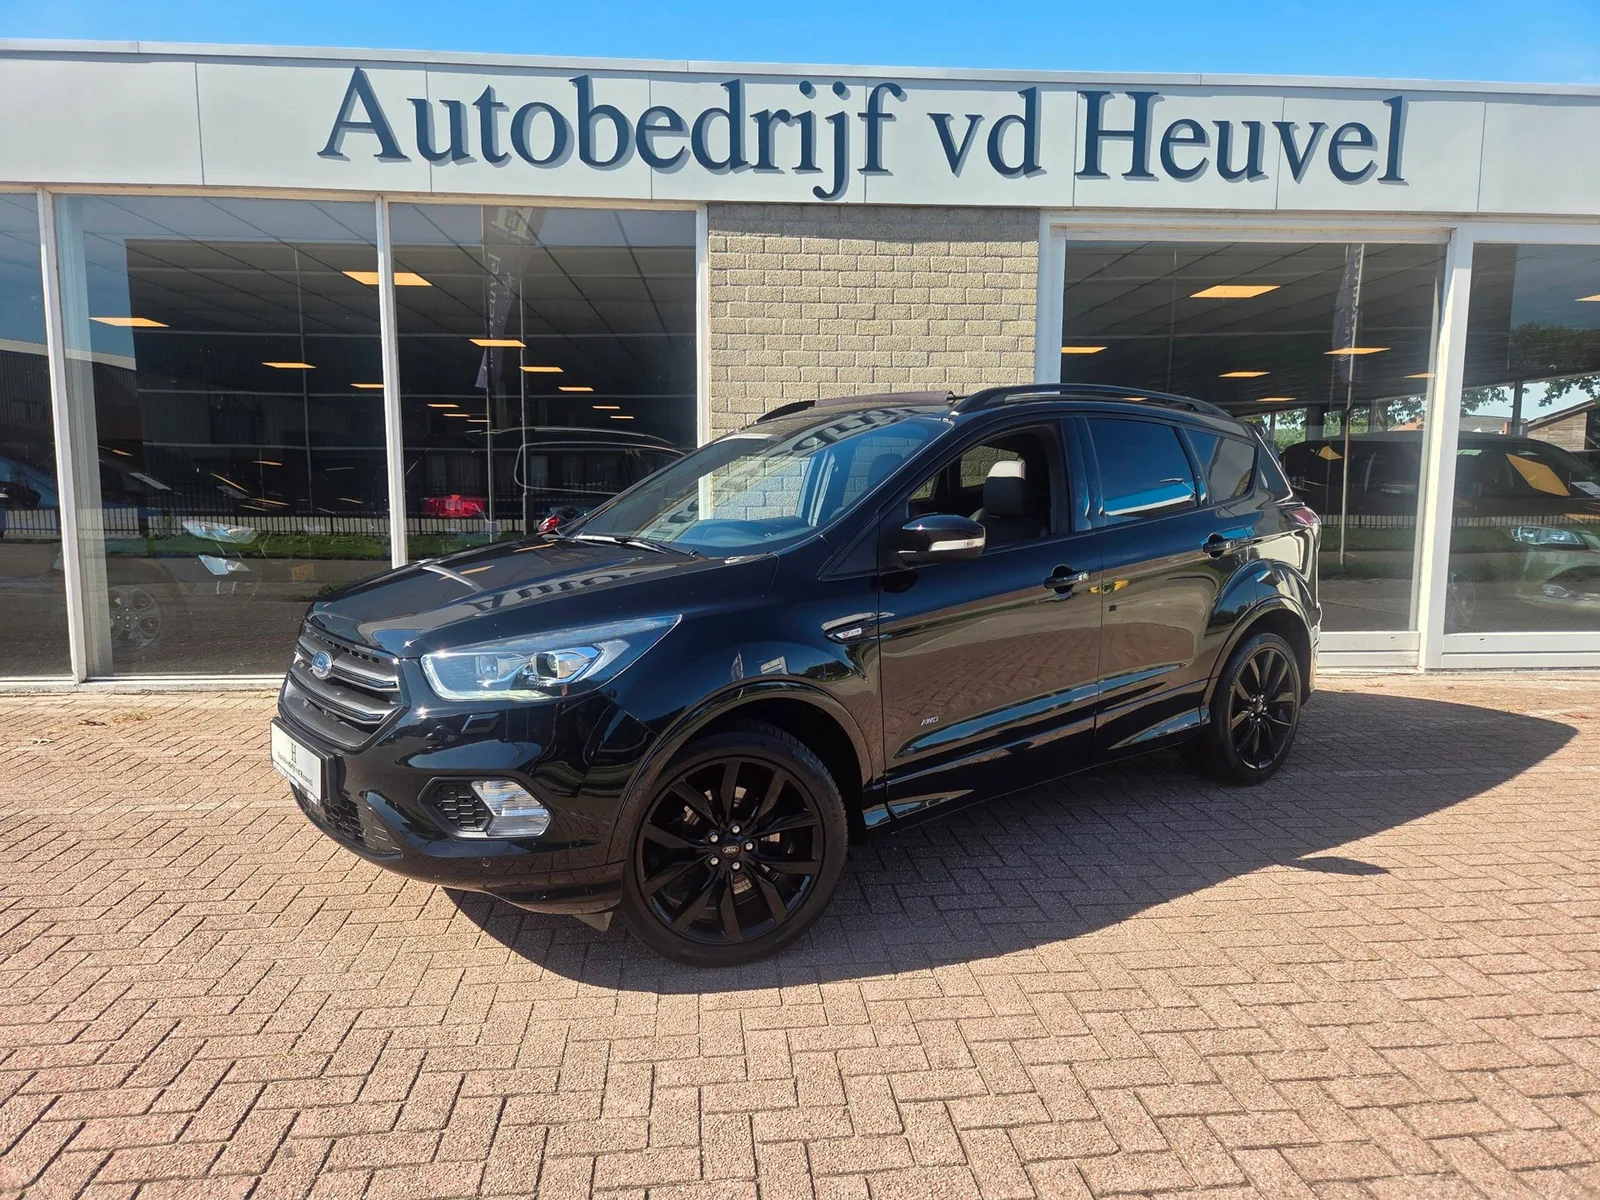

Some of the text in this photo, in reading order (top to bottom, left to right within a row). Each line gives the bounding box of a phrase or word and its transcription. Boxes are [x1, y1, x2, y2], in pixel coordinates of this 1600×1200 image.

[318, 66, 1405, 201] Autobedrijf vd Heuvel
[920, 716, 939, 726] AWD
